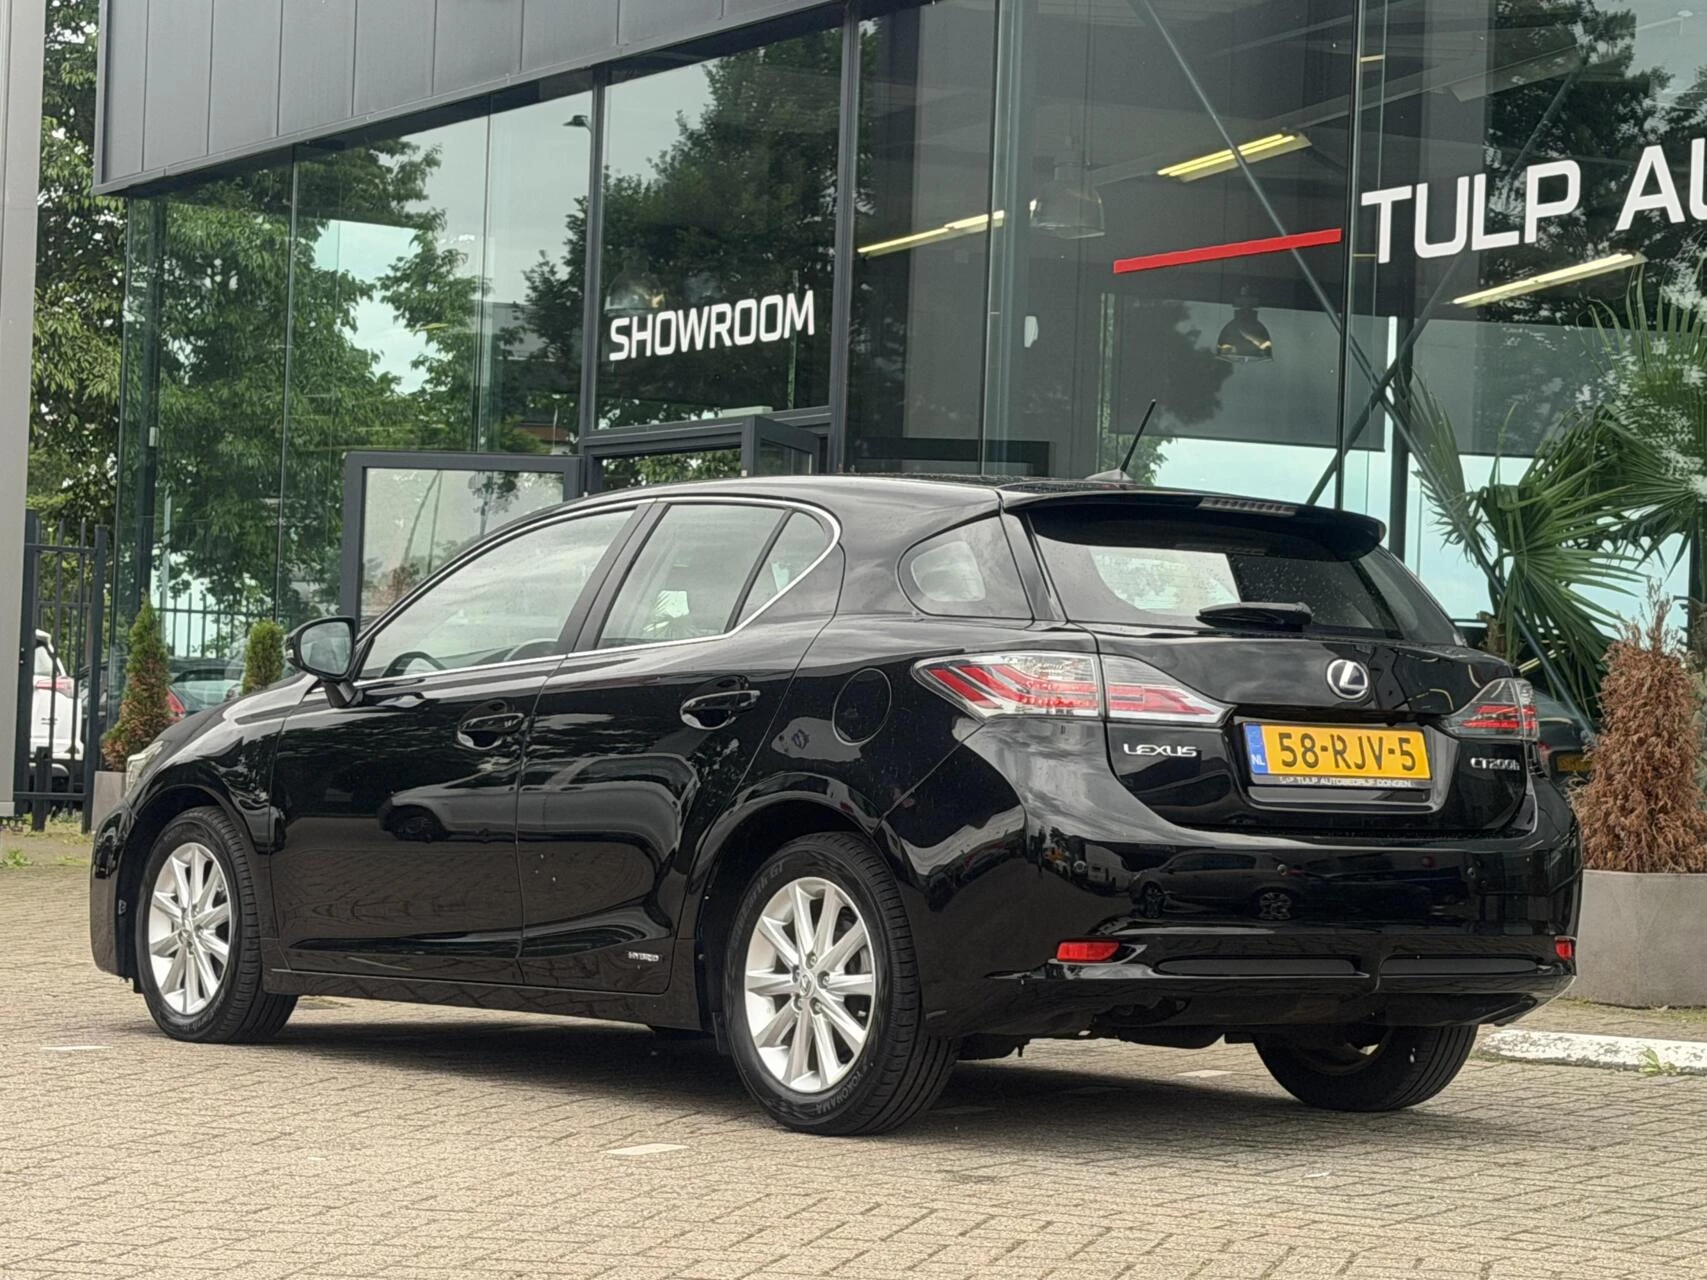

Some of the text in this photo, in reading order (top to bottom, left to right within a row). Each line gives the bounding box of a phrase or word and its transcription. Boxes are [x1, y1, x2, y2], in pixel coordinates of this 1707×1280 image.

[1361, 137, 1707, 264] TULP A
[608, 289, 815, 362] SHOWROOM
[1123, 743, 1198, 758] LEXUS
[1251, 754, 1265, 766] NL
[1278, 732, 1417, 772] 58-RJV-5
[1296, 776, 1319, 785] TULP
